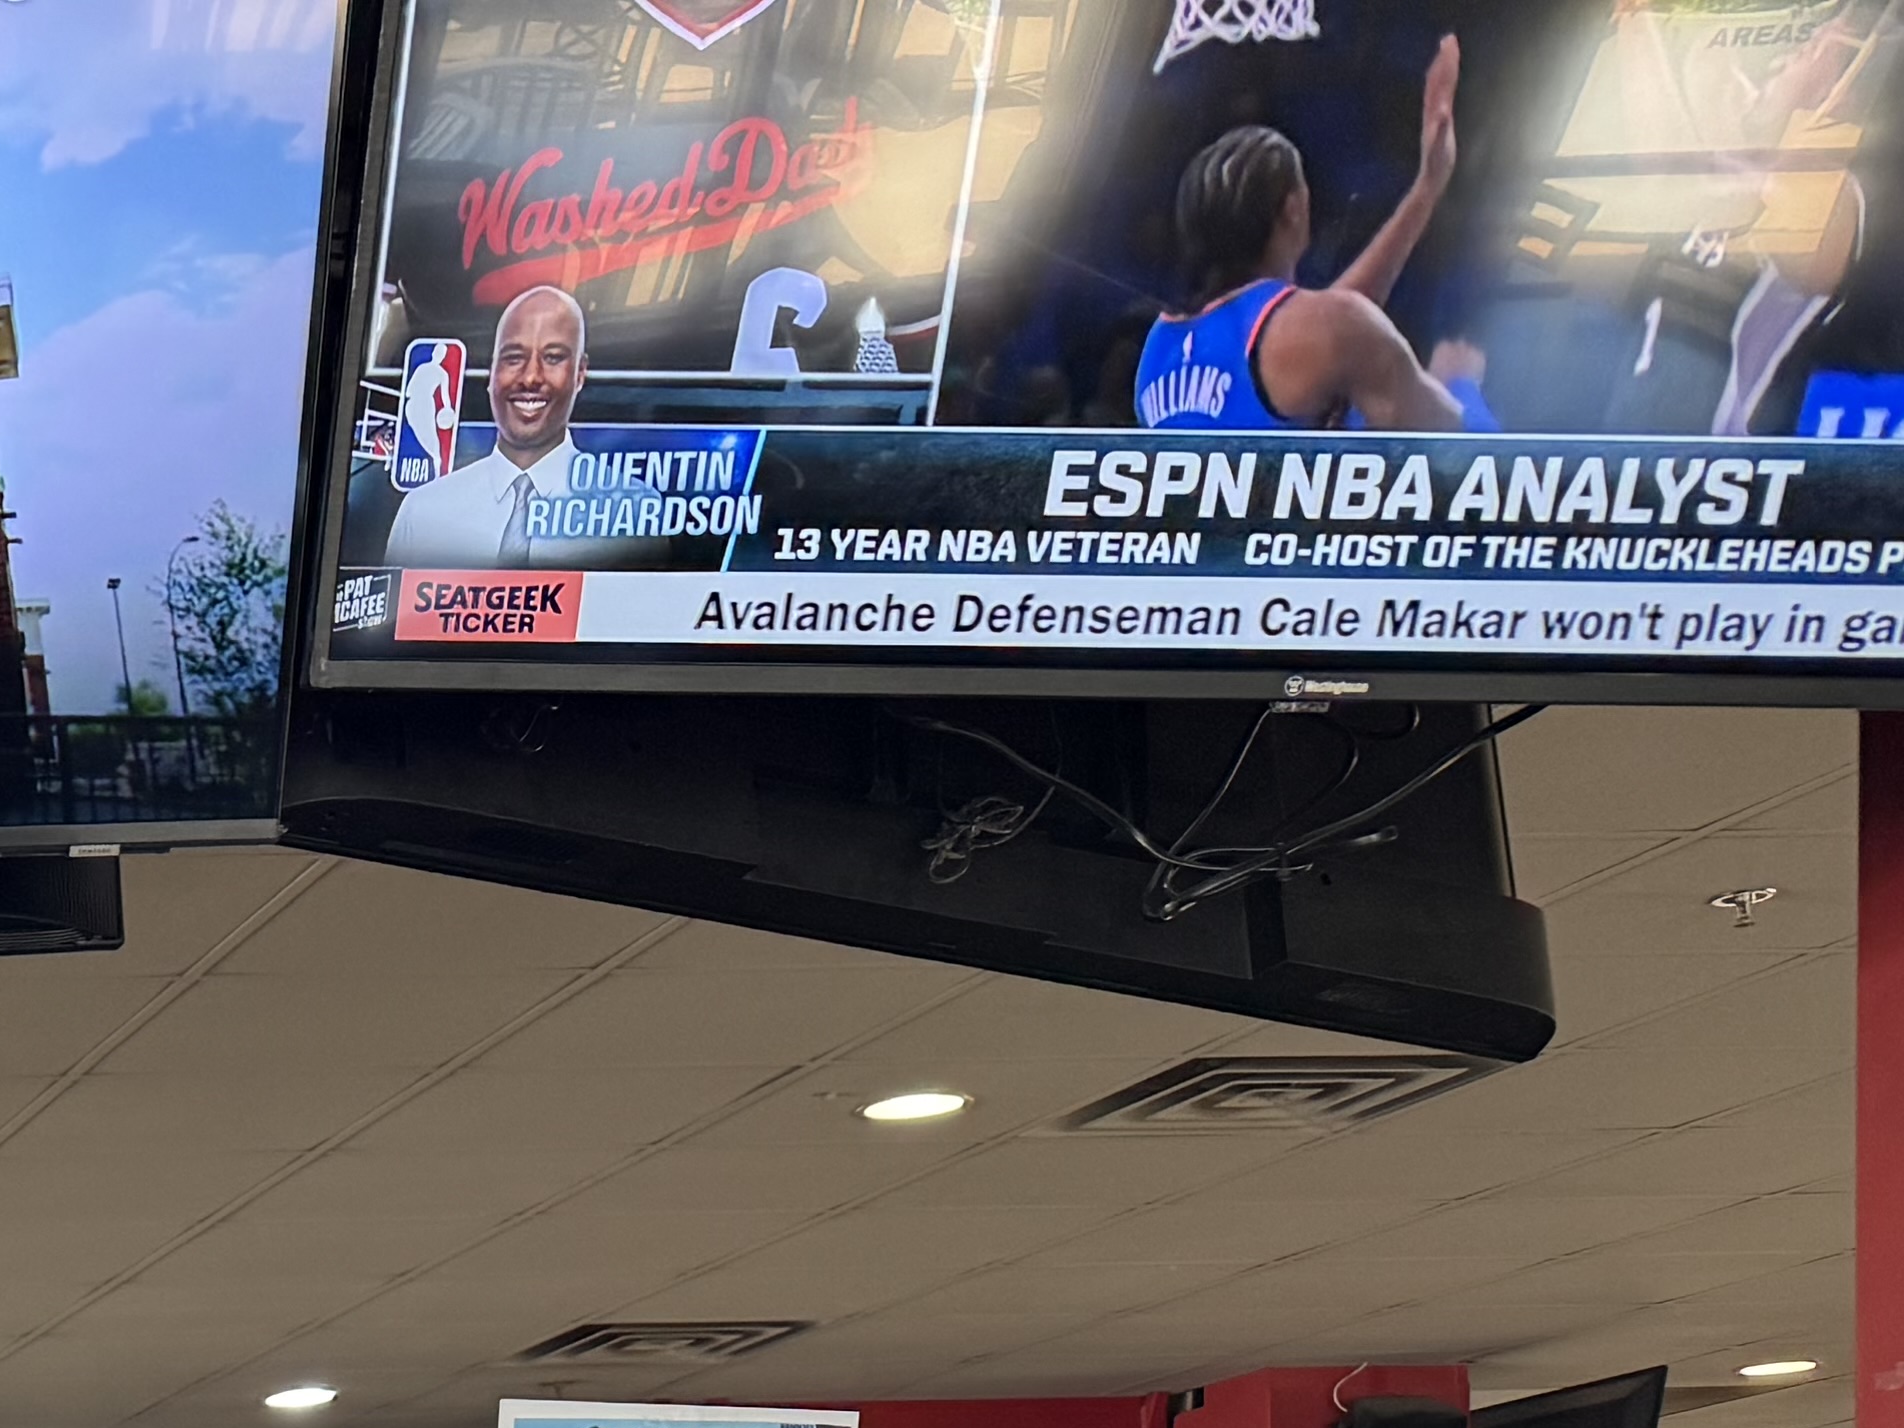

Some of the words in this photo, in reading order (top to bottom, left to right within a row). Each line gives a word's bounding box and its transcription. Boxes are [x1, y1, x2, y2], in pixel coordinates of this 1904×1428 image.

[457, 140, 706, 270] Washed
[398, 457, 432, 486] NBA
[570, 450, 735, 493] QUENTIN
[525, 495, 762, 540] RICHARDSON
[414, 581, 565, 615] SEATGEEK
[439, 612, 535, 634] TICKER
